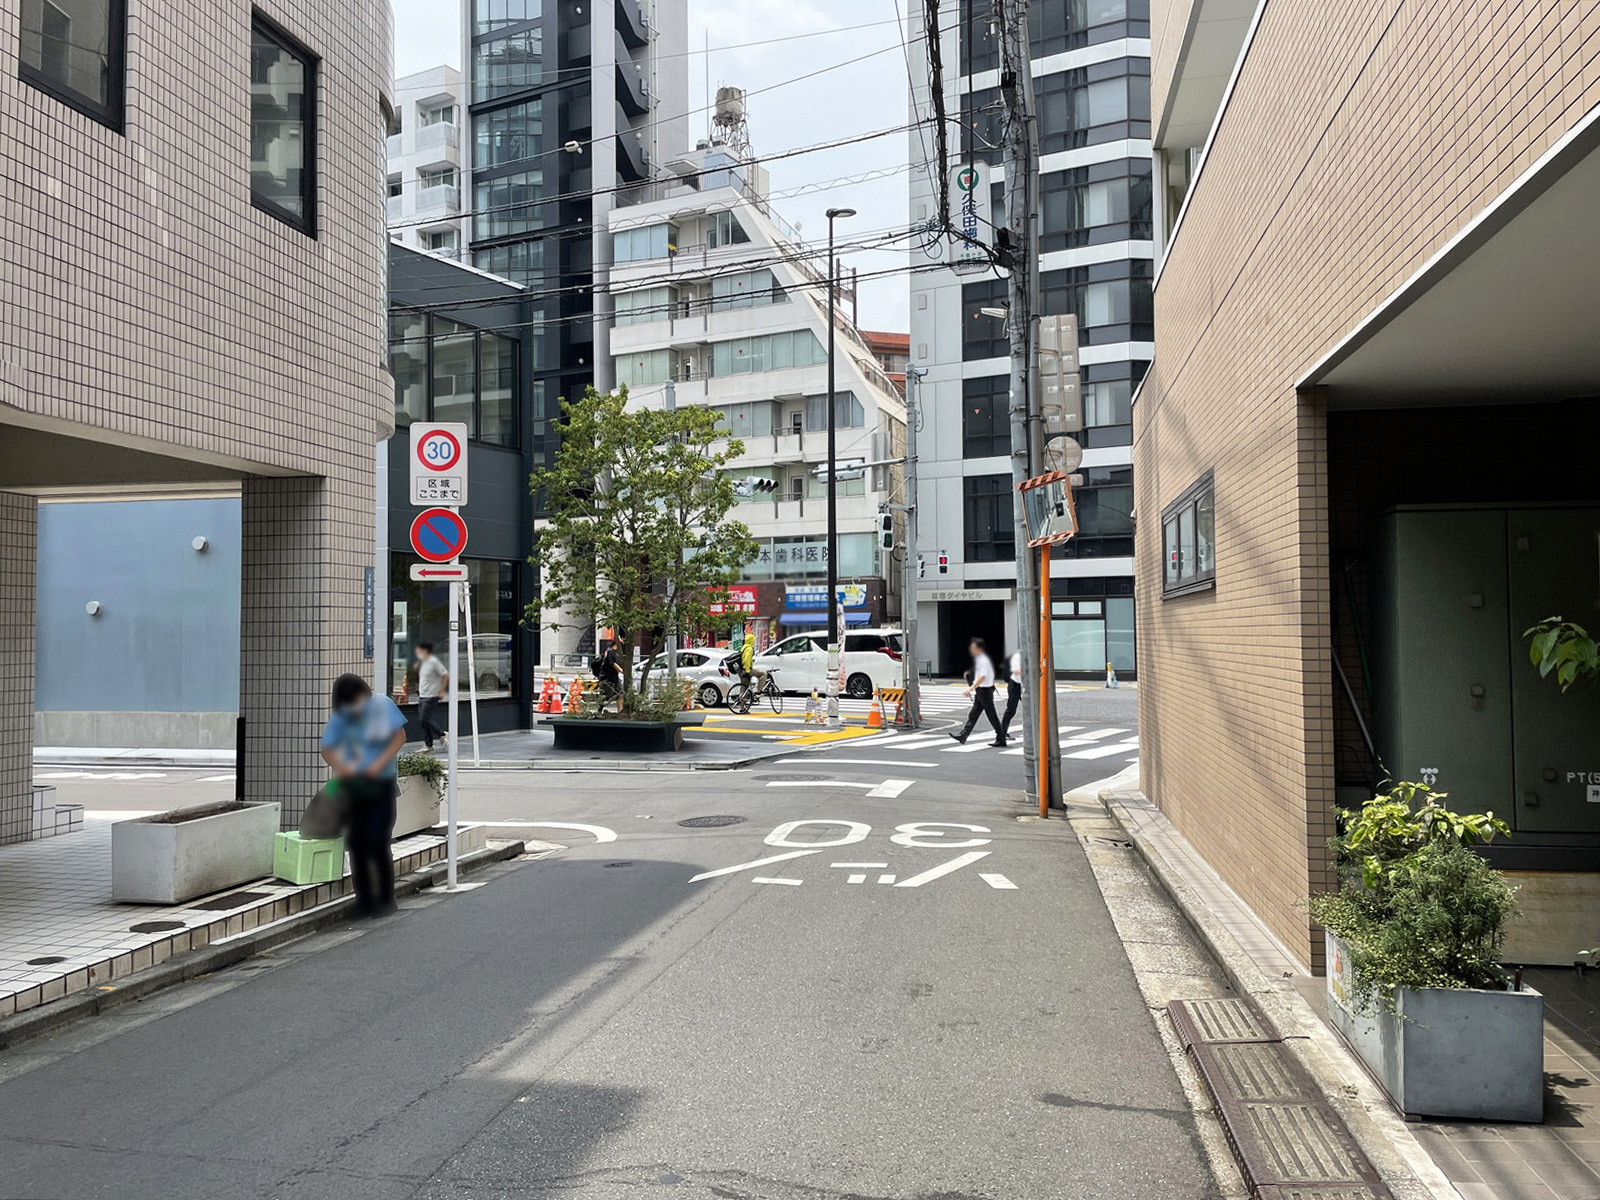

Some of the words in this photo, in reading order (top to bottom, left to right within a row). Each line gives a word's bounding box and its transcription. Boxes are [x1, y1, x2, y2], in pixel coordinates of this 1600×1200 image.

[427, 441, 451, 460] 30
[428, 479, 450, 488] 区域
[419, 489, 459, 499] ここまで
[750, 546, 829, 564] 本歯科医院
[763, 819, 992, 848] 30
[688, 849, 1019, 890] ゾーン
